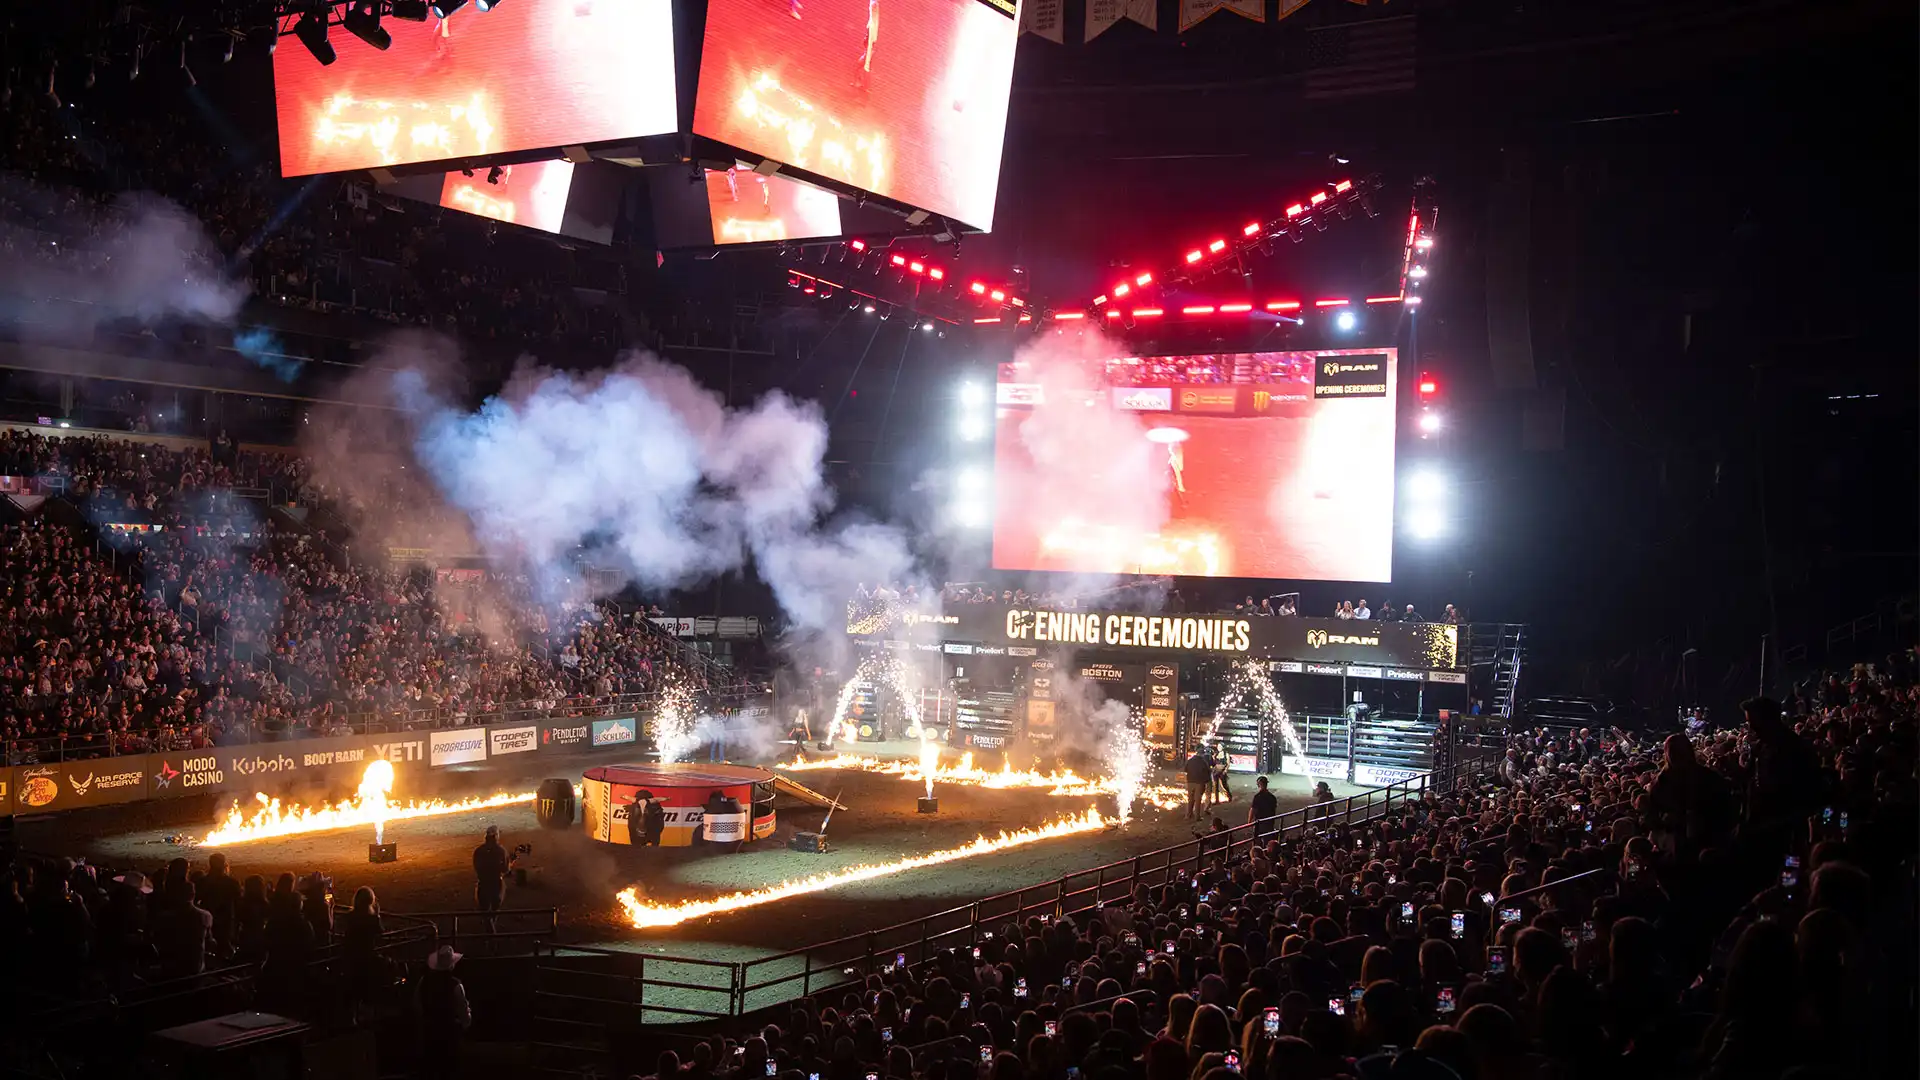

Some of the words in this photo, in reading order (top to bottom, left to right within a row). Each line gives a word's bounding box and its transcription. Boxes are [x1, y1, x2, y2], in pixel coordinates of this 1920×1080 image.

[1316, 385, 1343, 394] OPENING
[1344, 384, 1386, 394] CEREMONIES
[1006, 609, 1100, 644] OPENING
[1105, 614, 1251, 651] CEREMONIES
[1328, 635, 1379, 646] RAM
[1081, 668, 1122, 678] BOSTON
[1307, 665, 1344, 675] Priefert
[1387, 669, 1425, 680] Priefert
[493, 730, 534, 743] COOPER
[552, 725, 588, 740] PENDLETON
[432, 738, 484, 754] PROGRESSIVE
[499, 739, 528, 749] TIRES
[973, 734, 1005, 747] PENDLETON
[304, 753, 334, 767] BOOT
[335, 749, 364, 763] BARN
[373, 741, 425, 762] YETI
[183, 756, 217, 773] MODO
[233, 754, 294, 775] Kubota
[94, 774, 111, 783] AIR
[112, 771, 143, 781] FORCE
[183, 770, 224, 787] CASINO
[1367, 768, 1418, 778] COOPER
[97, 778, 140, 789] RESERVE
